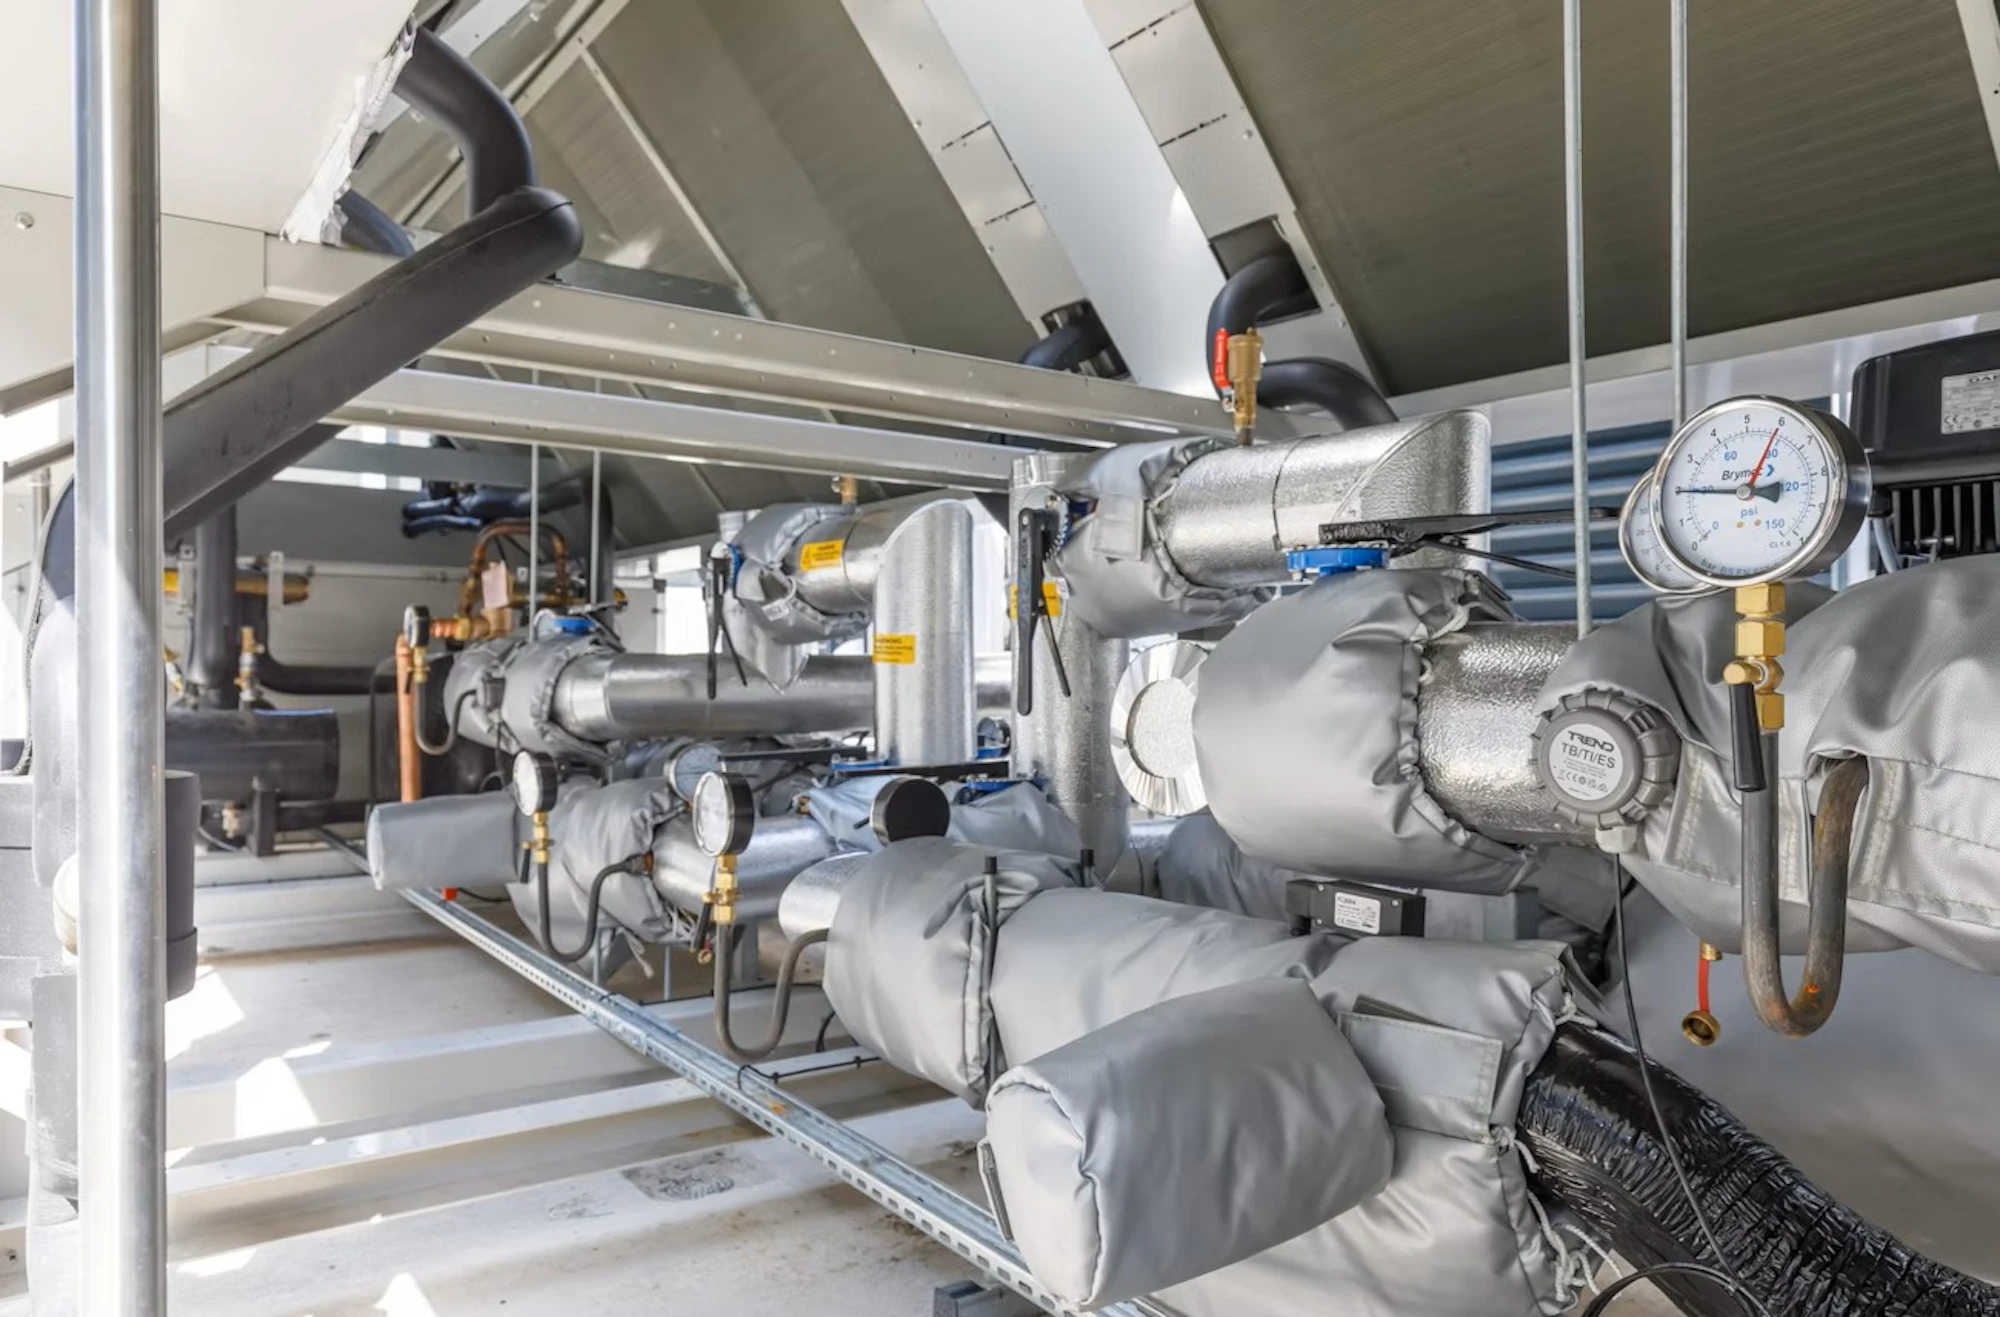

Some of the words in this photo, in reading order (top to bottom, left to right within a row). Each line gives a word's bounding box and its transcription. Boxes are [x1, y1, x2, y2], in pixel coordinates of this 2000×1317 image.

[1743, 414, 1750, 423] 5
[1778, 416, 1785, 427] 6
[1710, 428, 1717, 437] 4
[1806, 435, 1813, 445] 7
[1687, 453, 1693, 463] 3
[1723, 450, 1738, 461] 60
[1780, 482, 1799, 493] 120
[1740, 506, 1758, 519] psi
[1679, 518, 1684, 528] 1
[1712, 520, 1719, 530] 0
[1765, 518, 1785, 530] 150
[1692, 541, 1698, 551] 0
[1701, 557, 1716, 570] bar
[1567, 730, 1615, 753] TREND
[1561, 741, 1616, 769] TB/TI/ES
